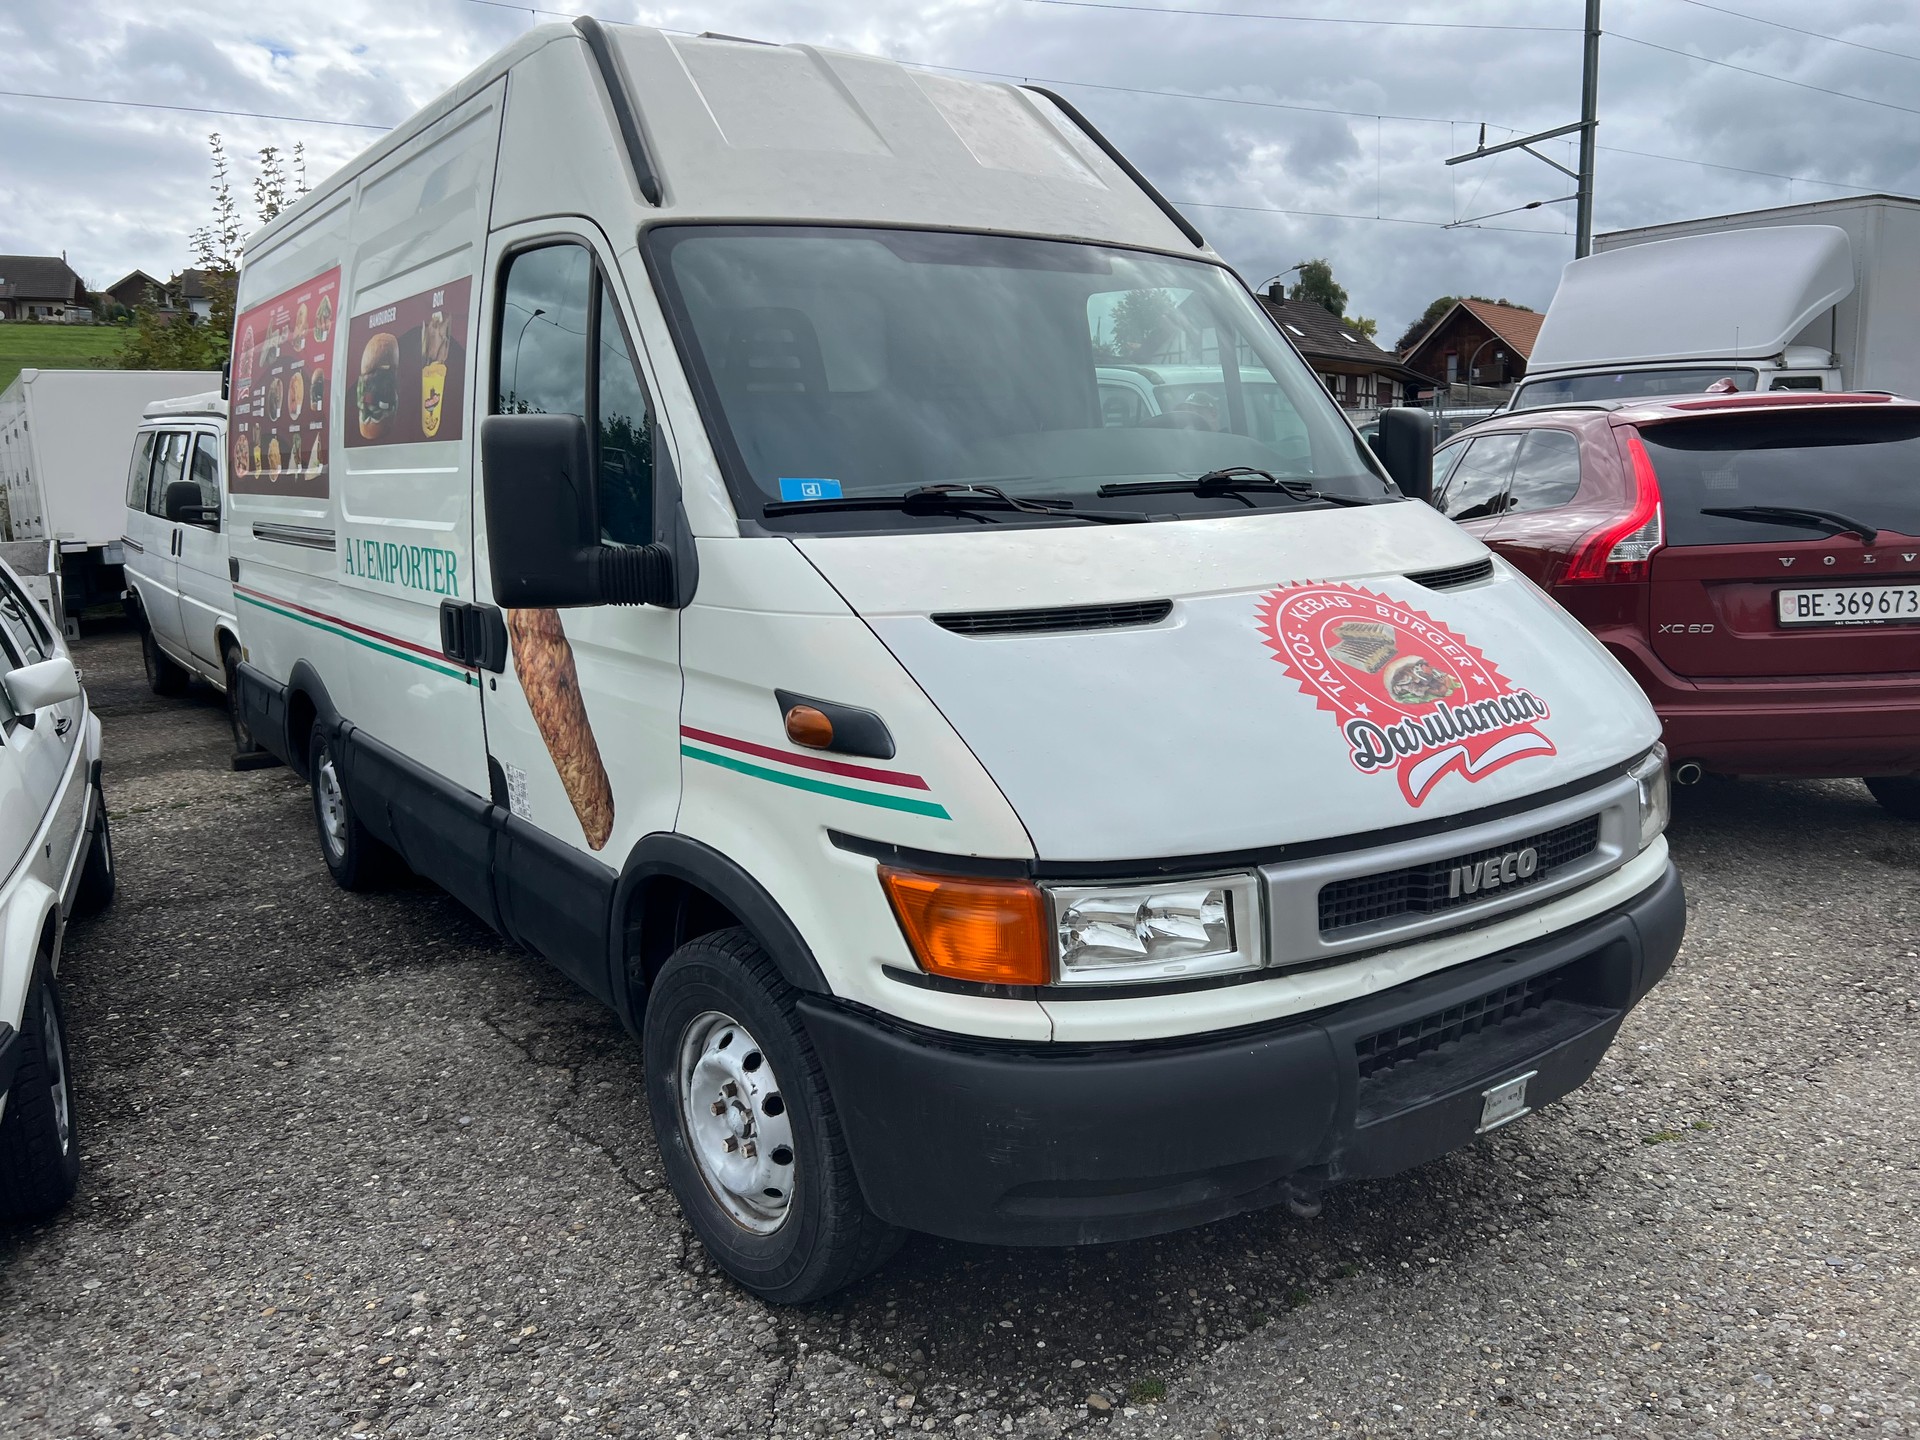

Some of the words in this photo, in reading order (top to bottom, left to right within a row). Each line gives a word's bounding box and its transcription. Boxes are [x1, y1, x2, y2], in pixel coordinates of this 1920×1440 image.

[432, 290, 445, 308] BOX
[345, 537, 355, 576] A
[355, 538, 460, 597] L'EMPORTER
[1288, 595, 1353, 622] KEBAB
[1375, 604, 1473, 668] BURGER
[1287, 631, 1347, 698] TACOS
[1346, 691, 1545, 769] Darulaman
[1450, 847, 1538, 899] IVECO
